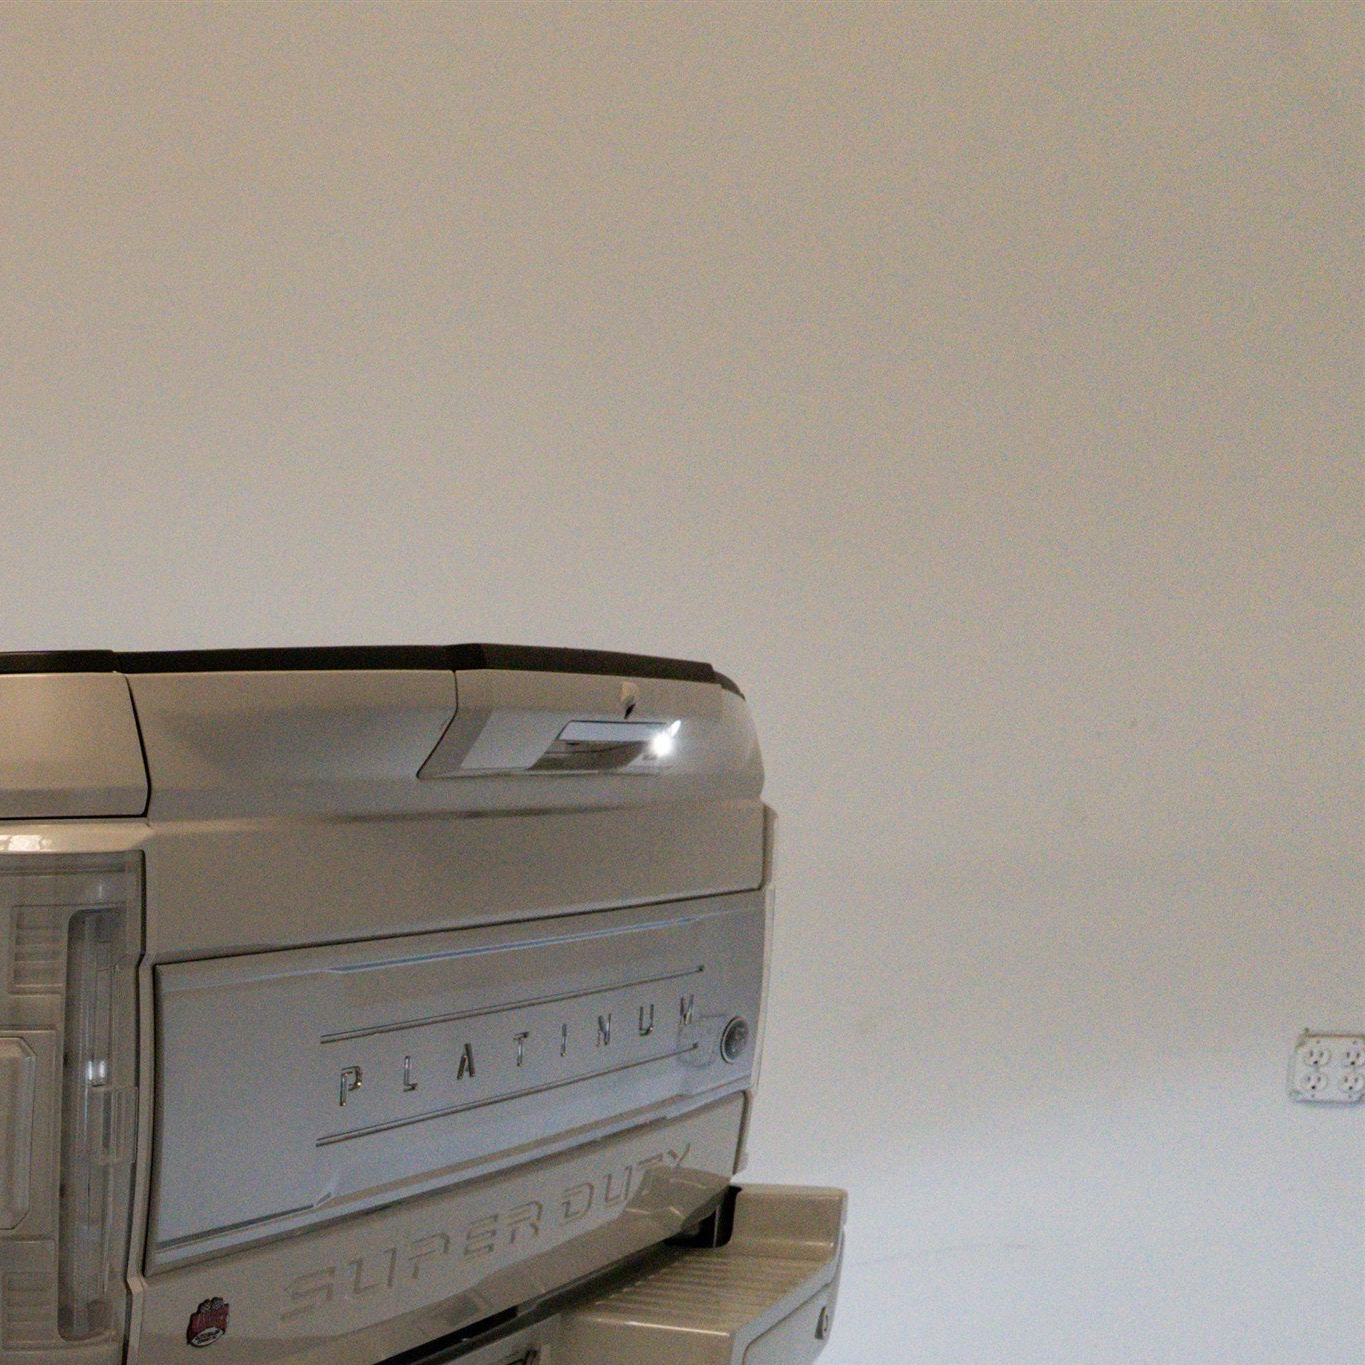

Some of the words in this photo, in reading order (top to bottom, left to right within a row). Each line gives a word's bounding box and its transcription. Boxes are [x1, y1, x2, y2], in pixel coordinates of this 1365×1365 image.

[338, 993, 695, 1107] PLATINUM
[280, 1199, 544, 1322] SUPER
[560, 1142, 692, 1227] DUTY
